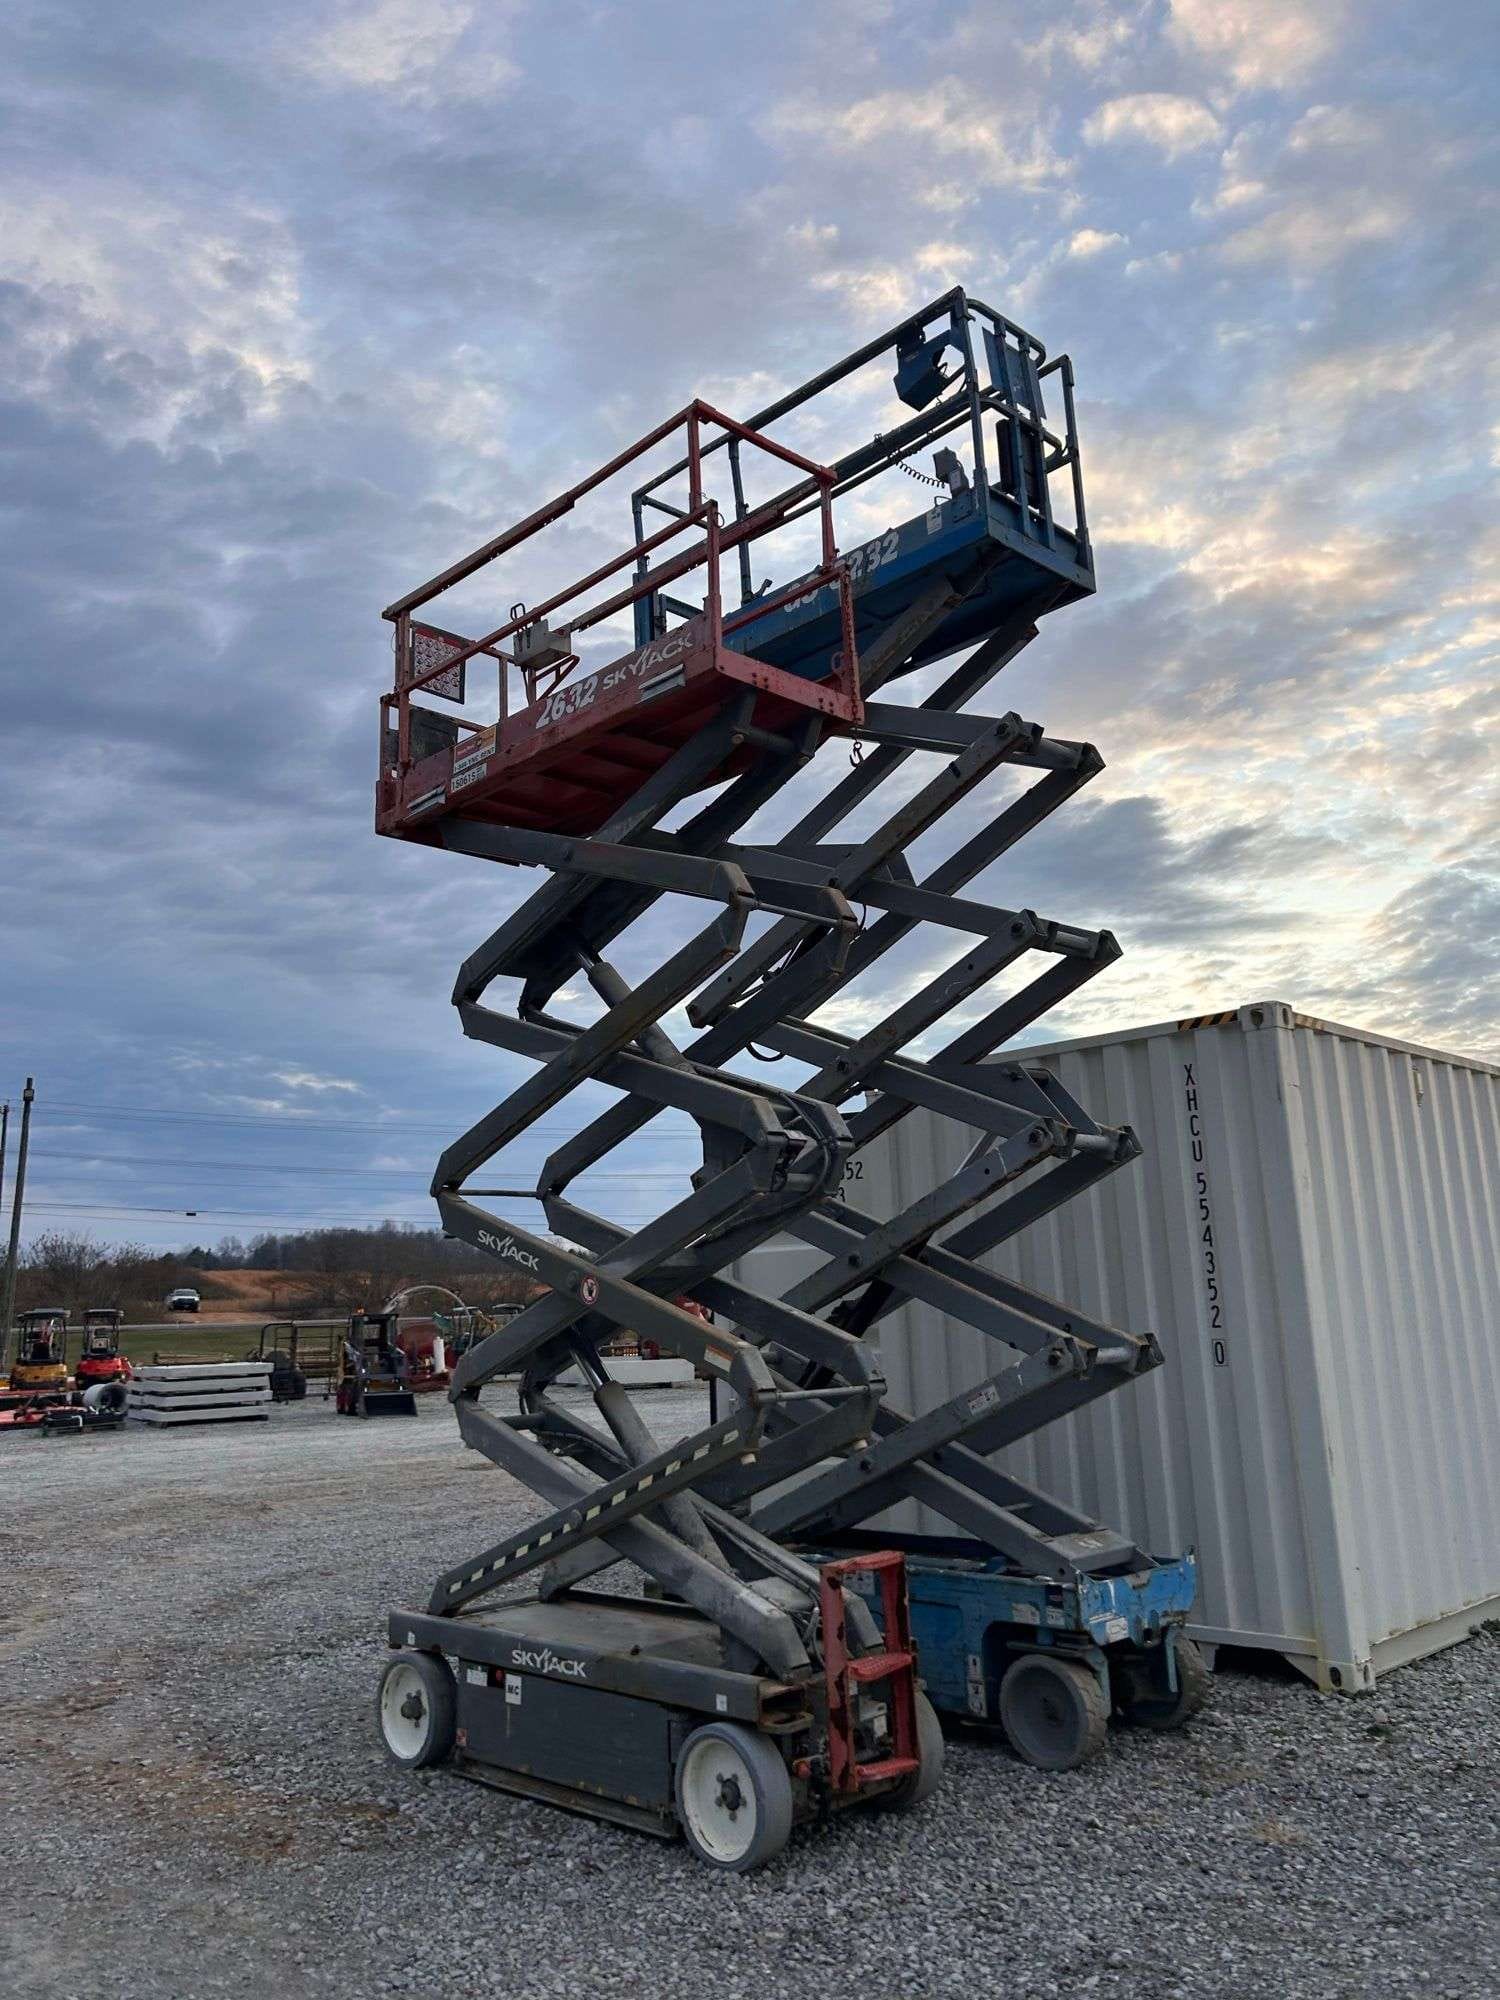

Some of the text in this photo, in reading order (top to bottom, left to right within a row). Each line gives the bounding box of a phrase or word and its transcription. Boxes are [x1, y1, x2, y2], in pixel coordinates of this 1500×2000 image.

[535, 632, 693, 729] 2632 SKYJACK
[840, 1161, 864, 1180] 52
[1183, 1063, 1203, 1163] XHCU
[1196, 1172, 1222, 1329] 554352
[477, 1229, 540, 1271] SKYJACK
[511, 1648, 587, 1678] SKYJACK
